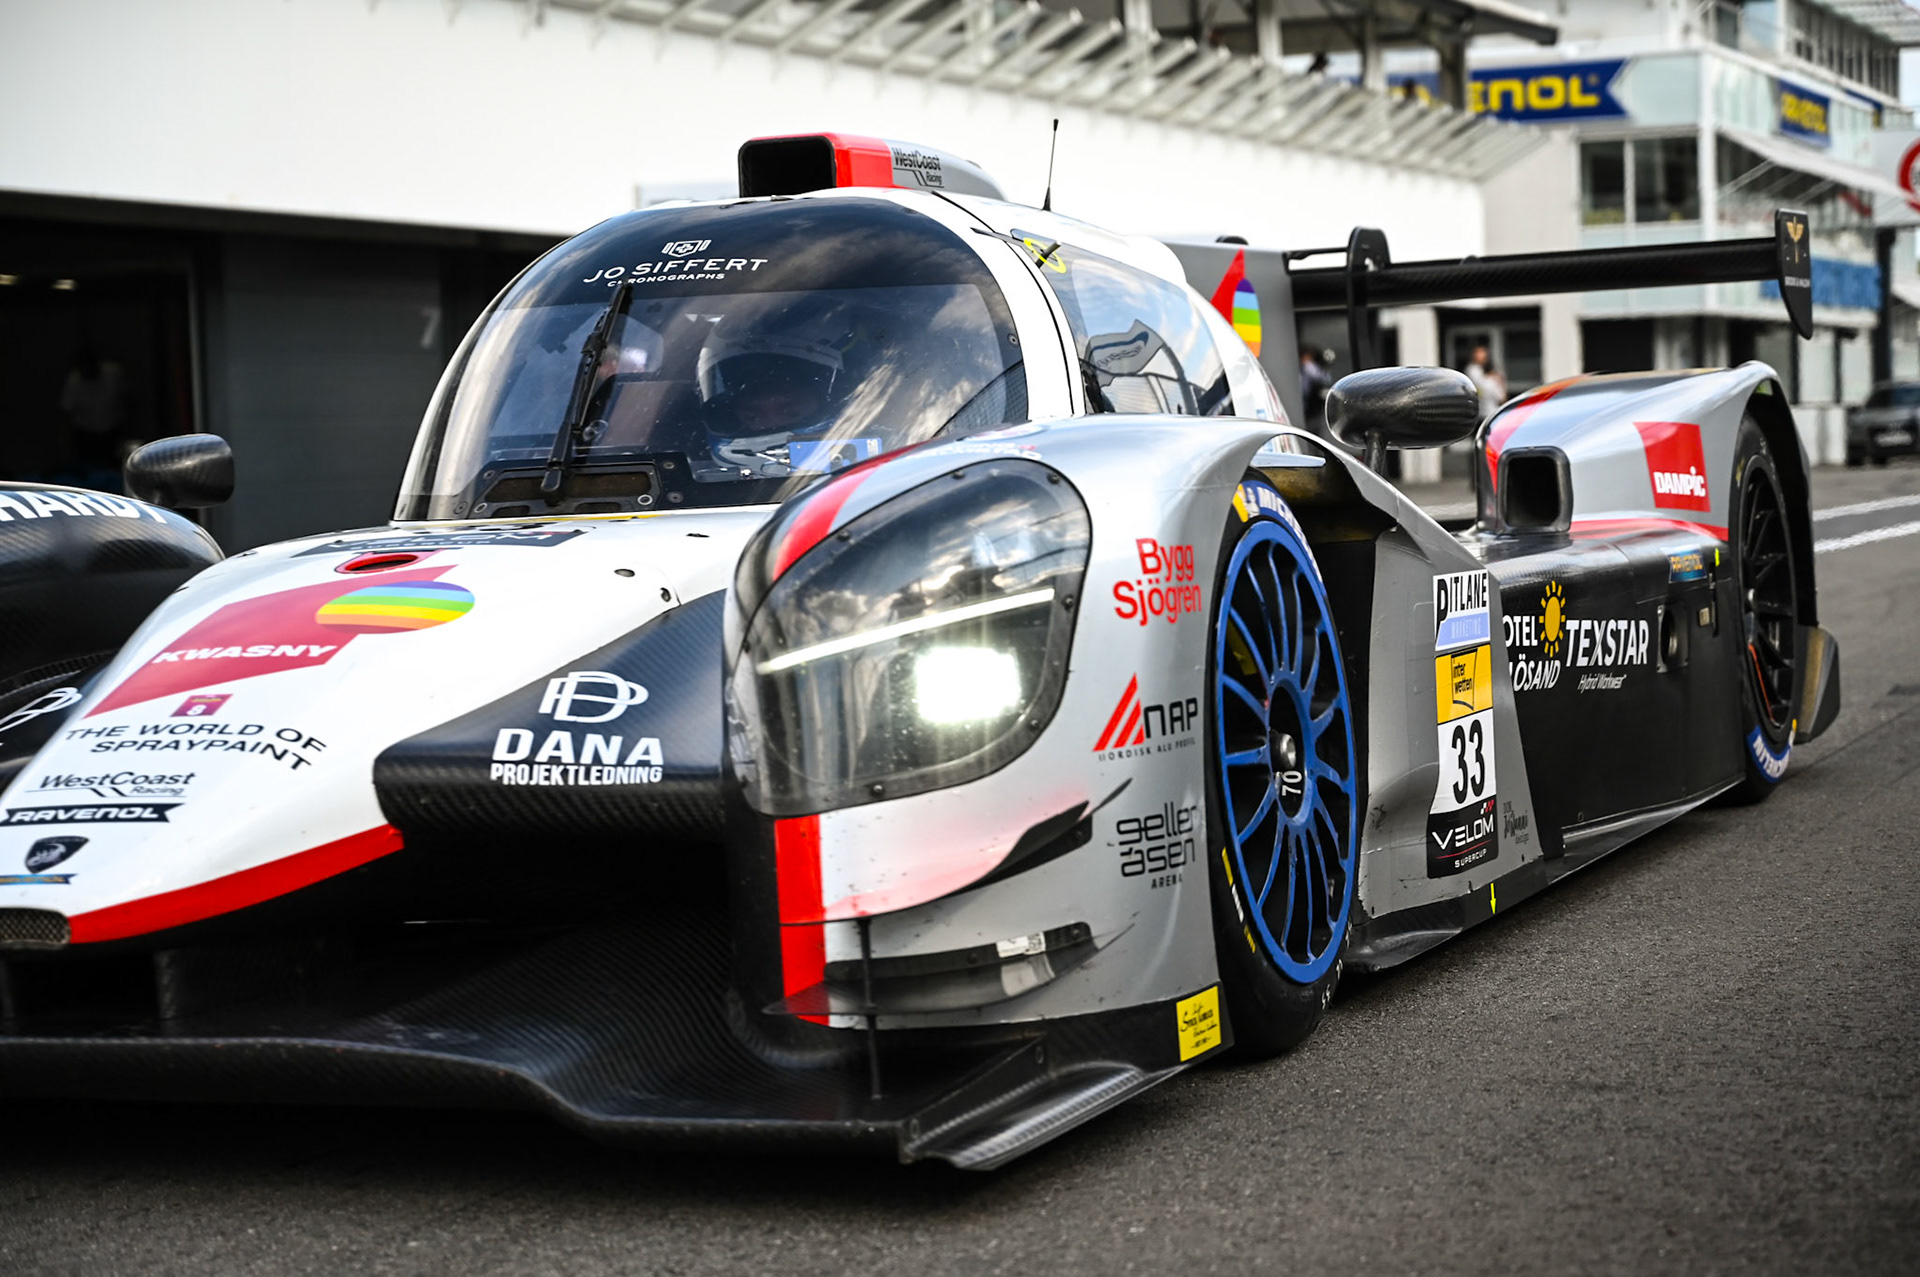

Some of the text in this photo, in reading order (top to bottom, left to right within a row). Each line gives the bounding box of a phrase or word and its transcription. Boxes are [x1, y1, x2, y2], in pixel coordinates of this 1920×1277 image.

[891, 146, 941, 171] WestCoast
[583, 258, 768, 283] JO SIFFERT
[1135, 537, 1195, 582] Bygg
[1112, 578, 1202, 626] Sjögren
[1436, 573, 1487, 625] PITLANE
[151, 644, 339, 664] KWASNY
[1565, 618, 1650, 668] TEXSTAR
[186, 703, 208, 716] 8
[65, 723, 328, 753] THE WORLD OF
[492, 727, 665, 766] DANA
[90, 739, 313, 771] SPRAYPAINT
[1451, 718, 1486, 805] 33
[39, 770, 196, 789] WestCoast
[490, 762, 664, 786] PROJEKTLEDNING
[1281, 770, 1303, 797] 70
[129, 785, 185, 797] Racing
[9, 806, 160, 824] RAVENOL
[1431, 813, 1494, 850] VELOM
[1454, 847, 1487, 868] SUPERCUP
